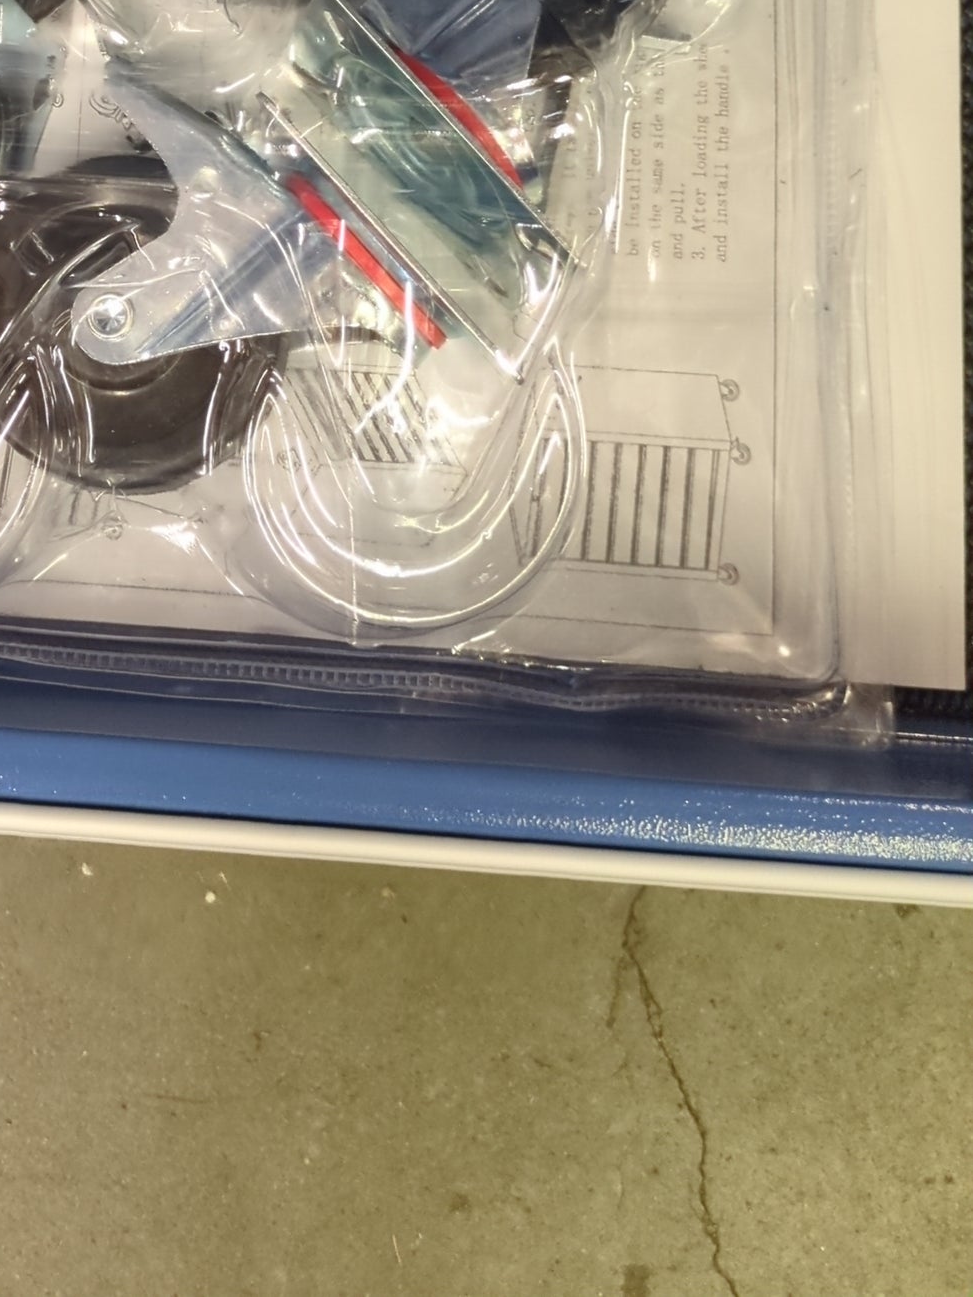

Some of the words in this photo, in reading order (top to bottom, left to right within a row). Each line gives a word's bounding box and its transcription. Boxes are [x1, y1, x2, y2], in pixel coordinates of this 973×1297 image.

[653, 87, 665, 105] as
[693, 80, 708, 105] the
[714, 65, 730, 117] handle
[630, 121, 642, 139] on
[651, 114, 665, 149] side
[714, 126, 729, 151] the
[691, 115, 709, 177] loading
[625, 147, 641, 228] installed
[651, 159, 664, 194] same
[670, 183, 686, 224] pull.
[713, 164, 728, 226] install
[648, 204, 662, 229] the
[690, 187, 707, 234] After
[626, 238, 639, 256] be
[650, 240, 662, 258] on
[670, 233, 683, 260] and
[691, 247, 706, 260] 3.
[712, 235, 728, 262] and
